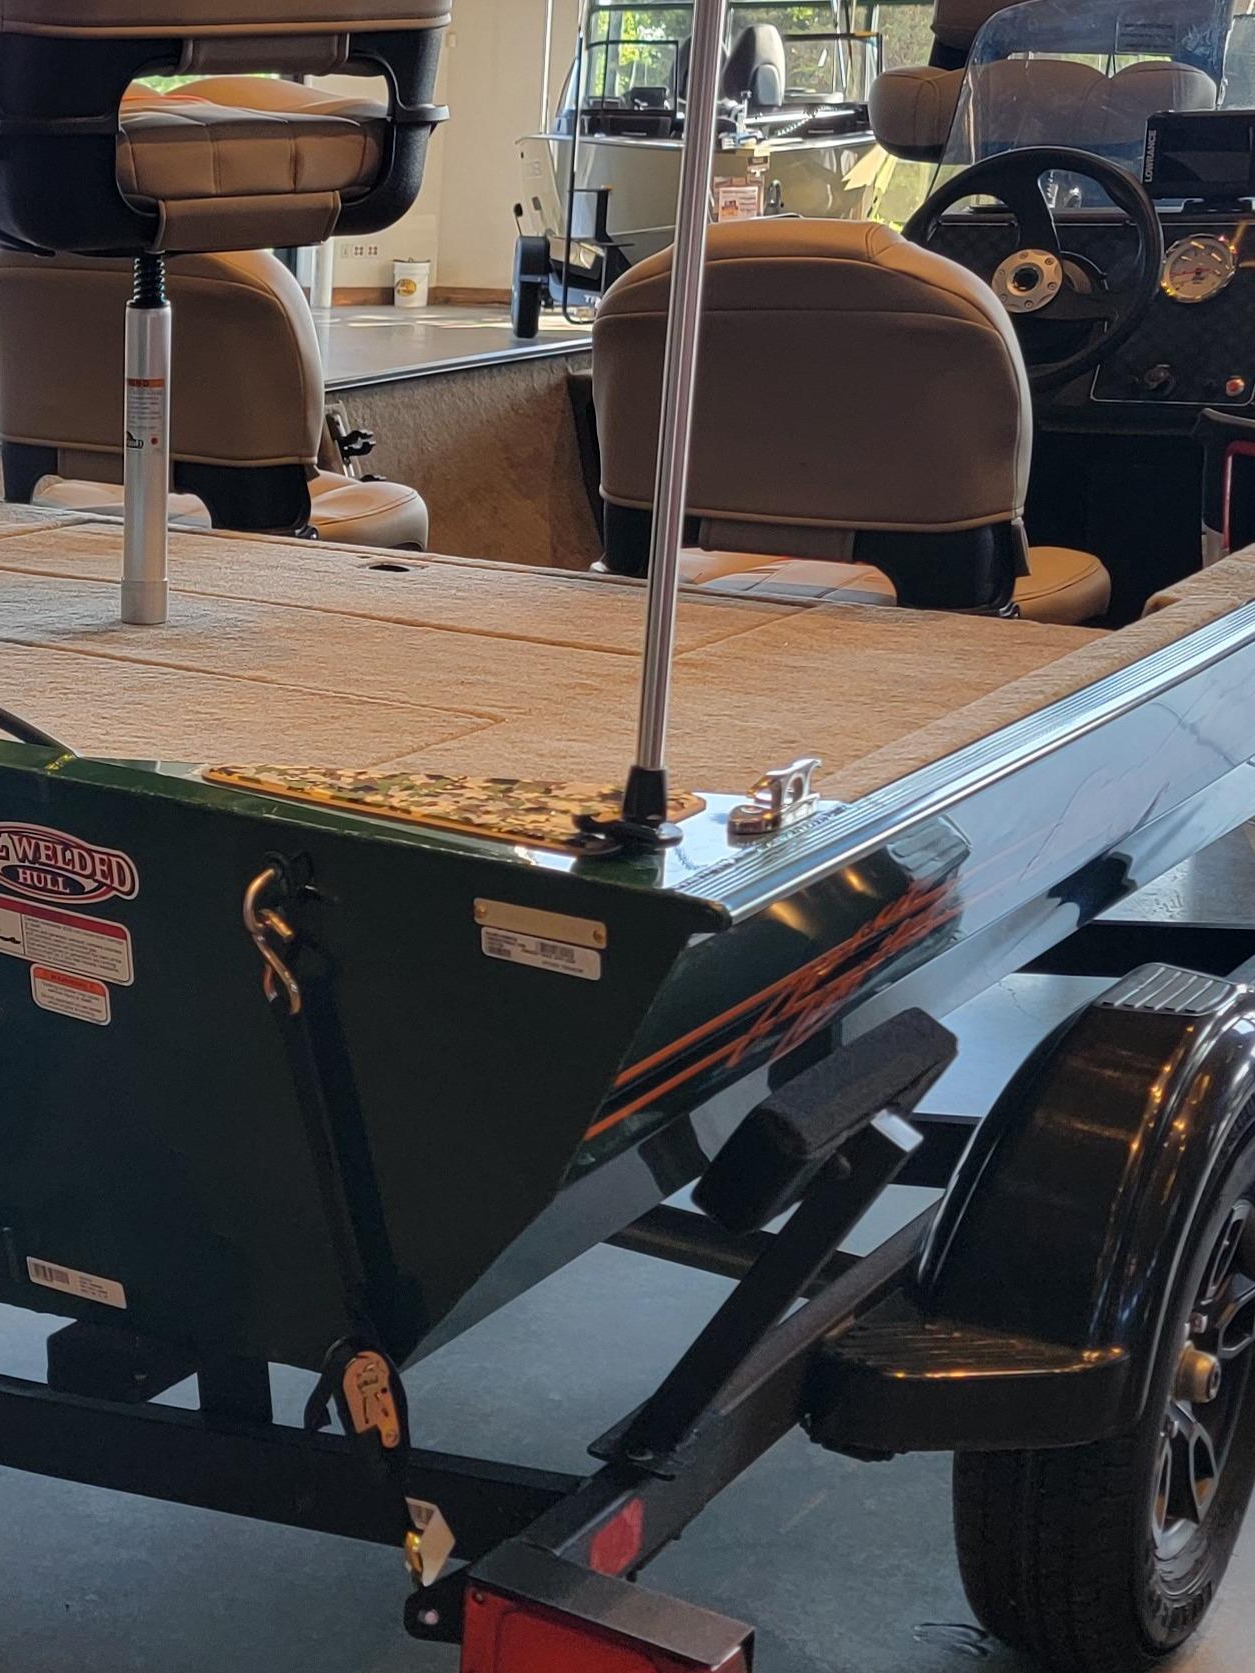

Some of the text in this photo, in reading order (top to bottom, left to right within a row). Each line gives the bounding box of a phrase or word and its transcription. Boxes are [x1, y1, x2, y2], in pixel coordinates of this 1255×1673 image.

[1145, 129, 1157, 183] LOWRANCE
[10, 834, 135, 894] WELDED
[16, 867, 71, 894] HULL
